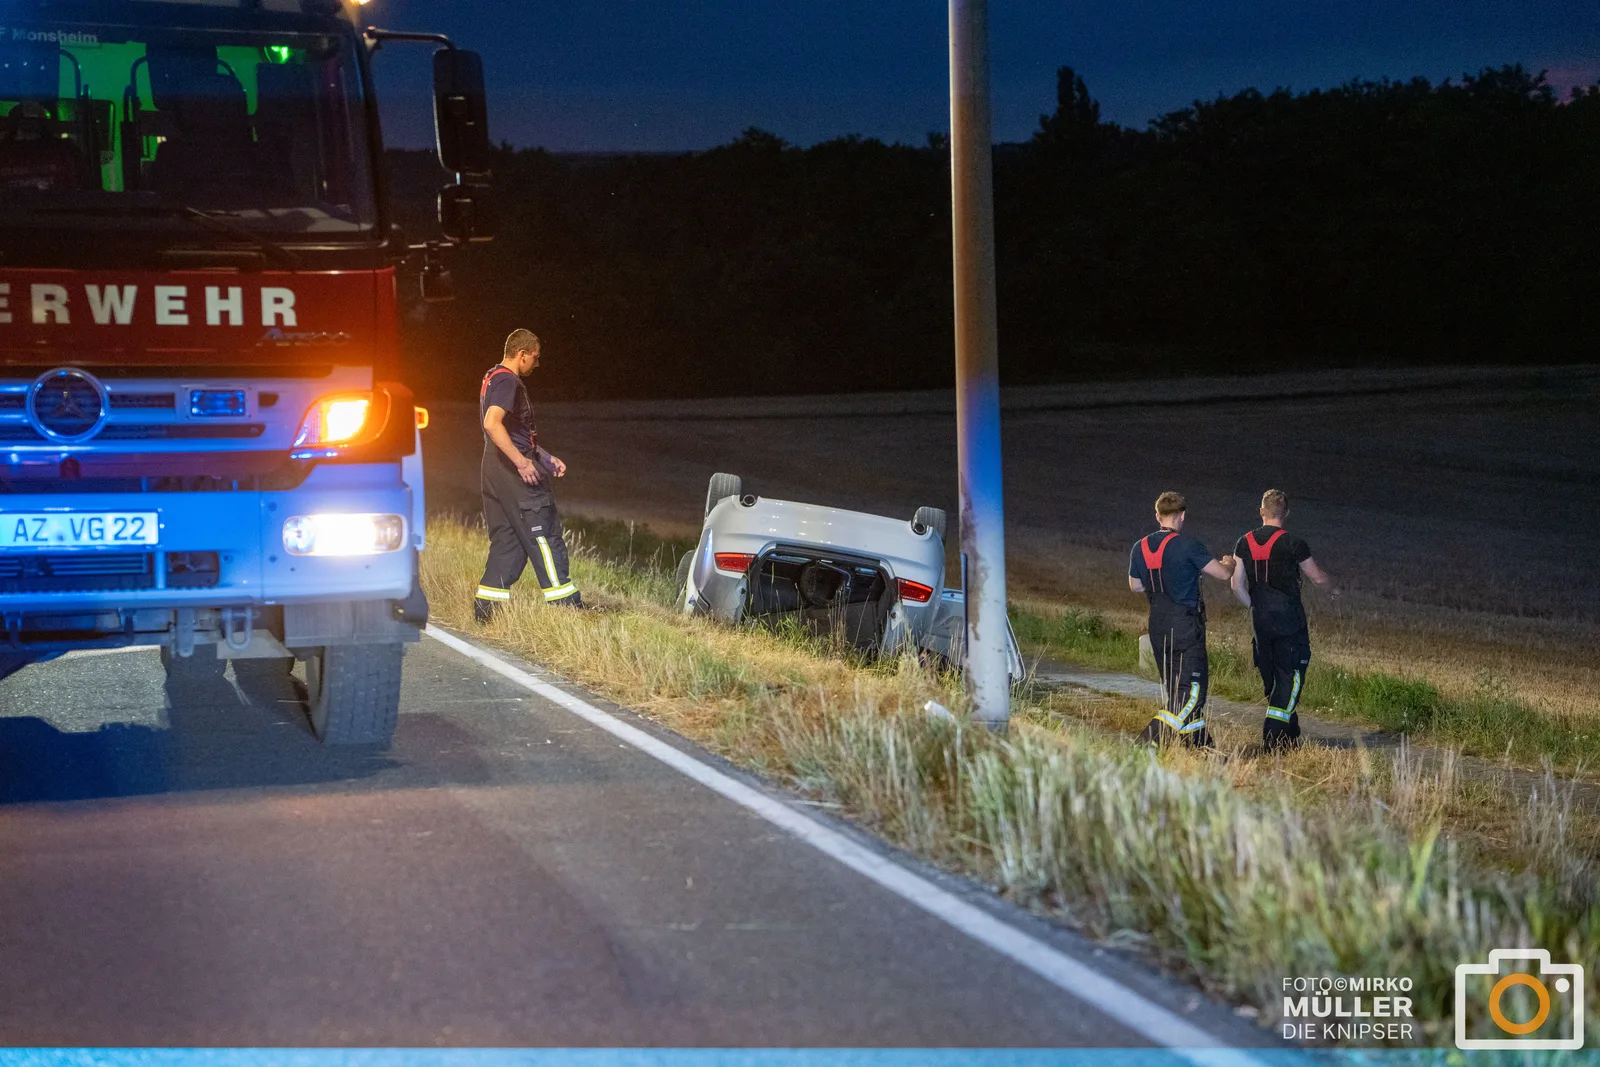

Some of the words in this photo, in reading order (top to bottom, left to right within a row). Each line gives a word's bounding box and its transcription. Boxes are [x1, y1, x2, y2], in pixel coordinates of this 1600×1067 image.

[12, 28, 98, 44] Monsheim
[13, 518, 48, 542] AZ
[113, 517, 145, 541] 22
